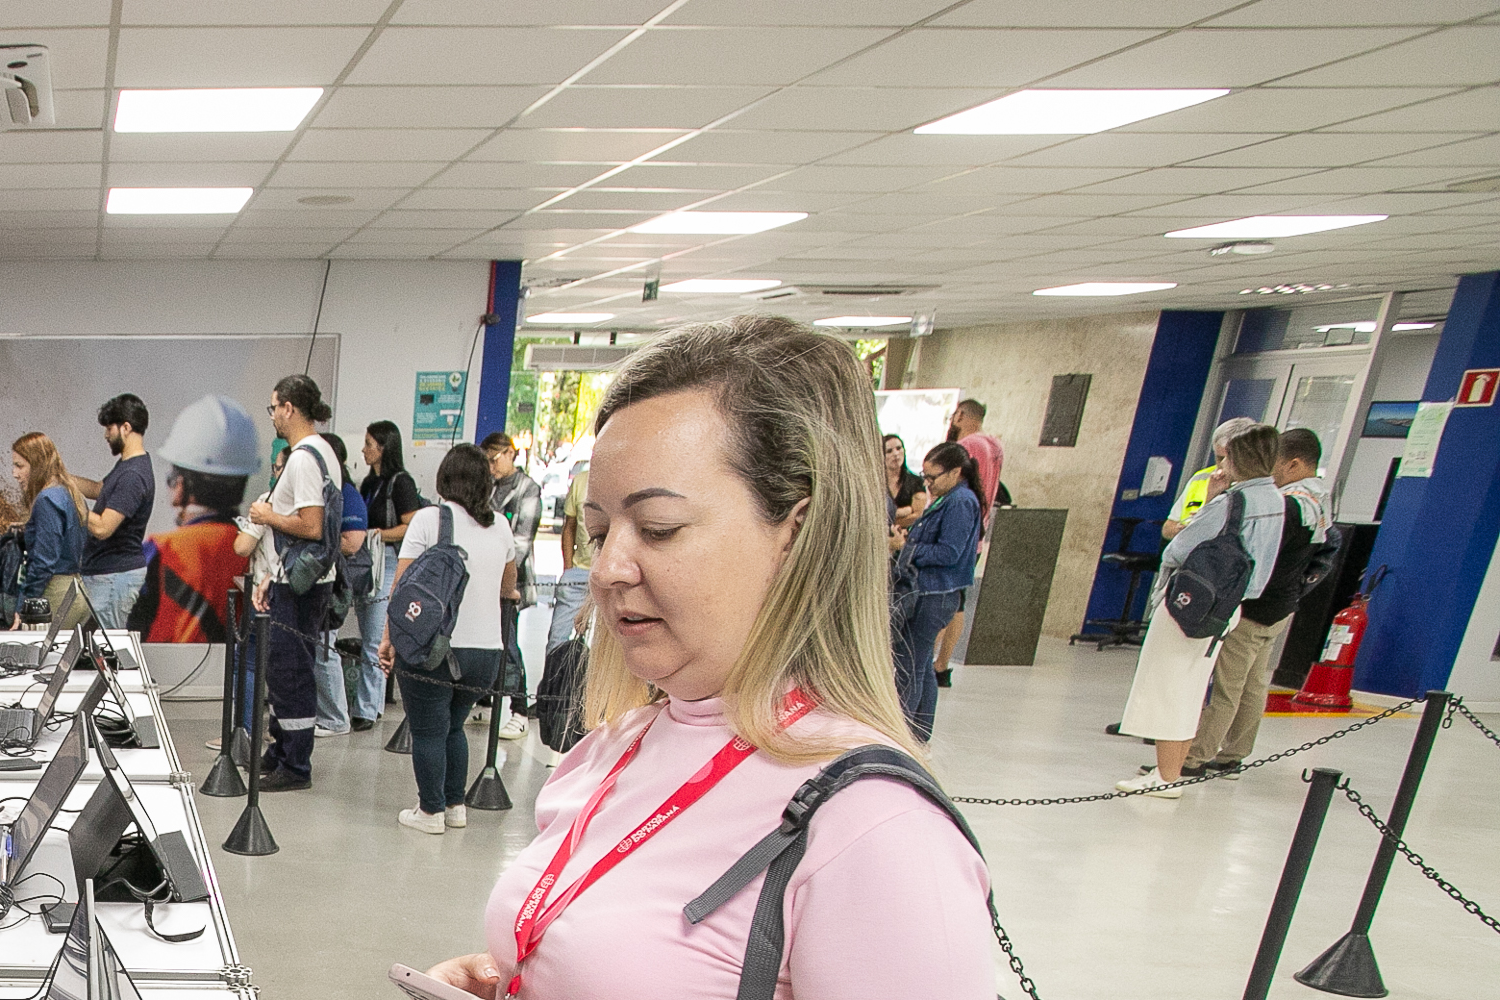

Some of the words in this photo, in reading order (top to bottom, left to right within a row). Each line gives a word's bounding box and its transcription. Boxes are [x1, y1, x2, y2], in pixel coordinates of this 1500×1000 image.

[778, 701, 805, 724] RANÁ
[630, 813, 665, 840] PORTOS
[647, 804, 680, 834] PARANÁ
[526, 887, 546, 920] PORTOS
